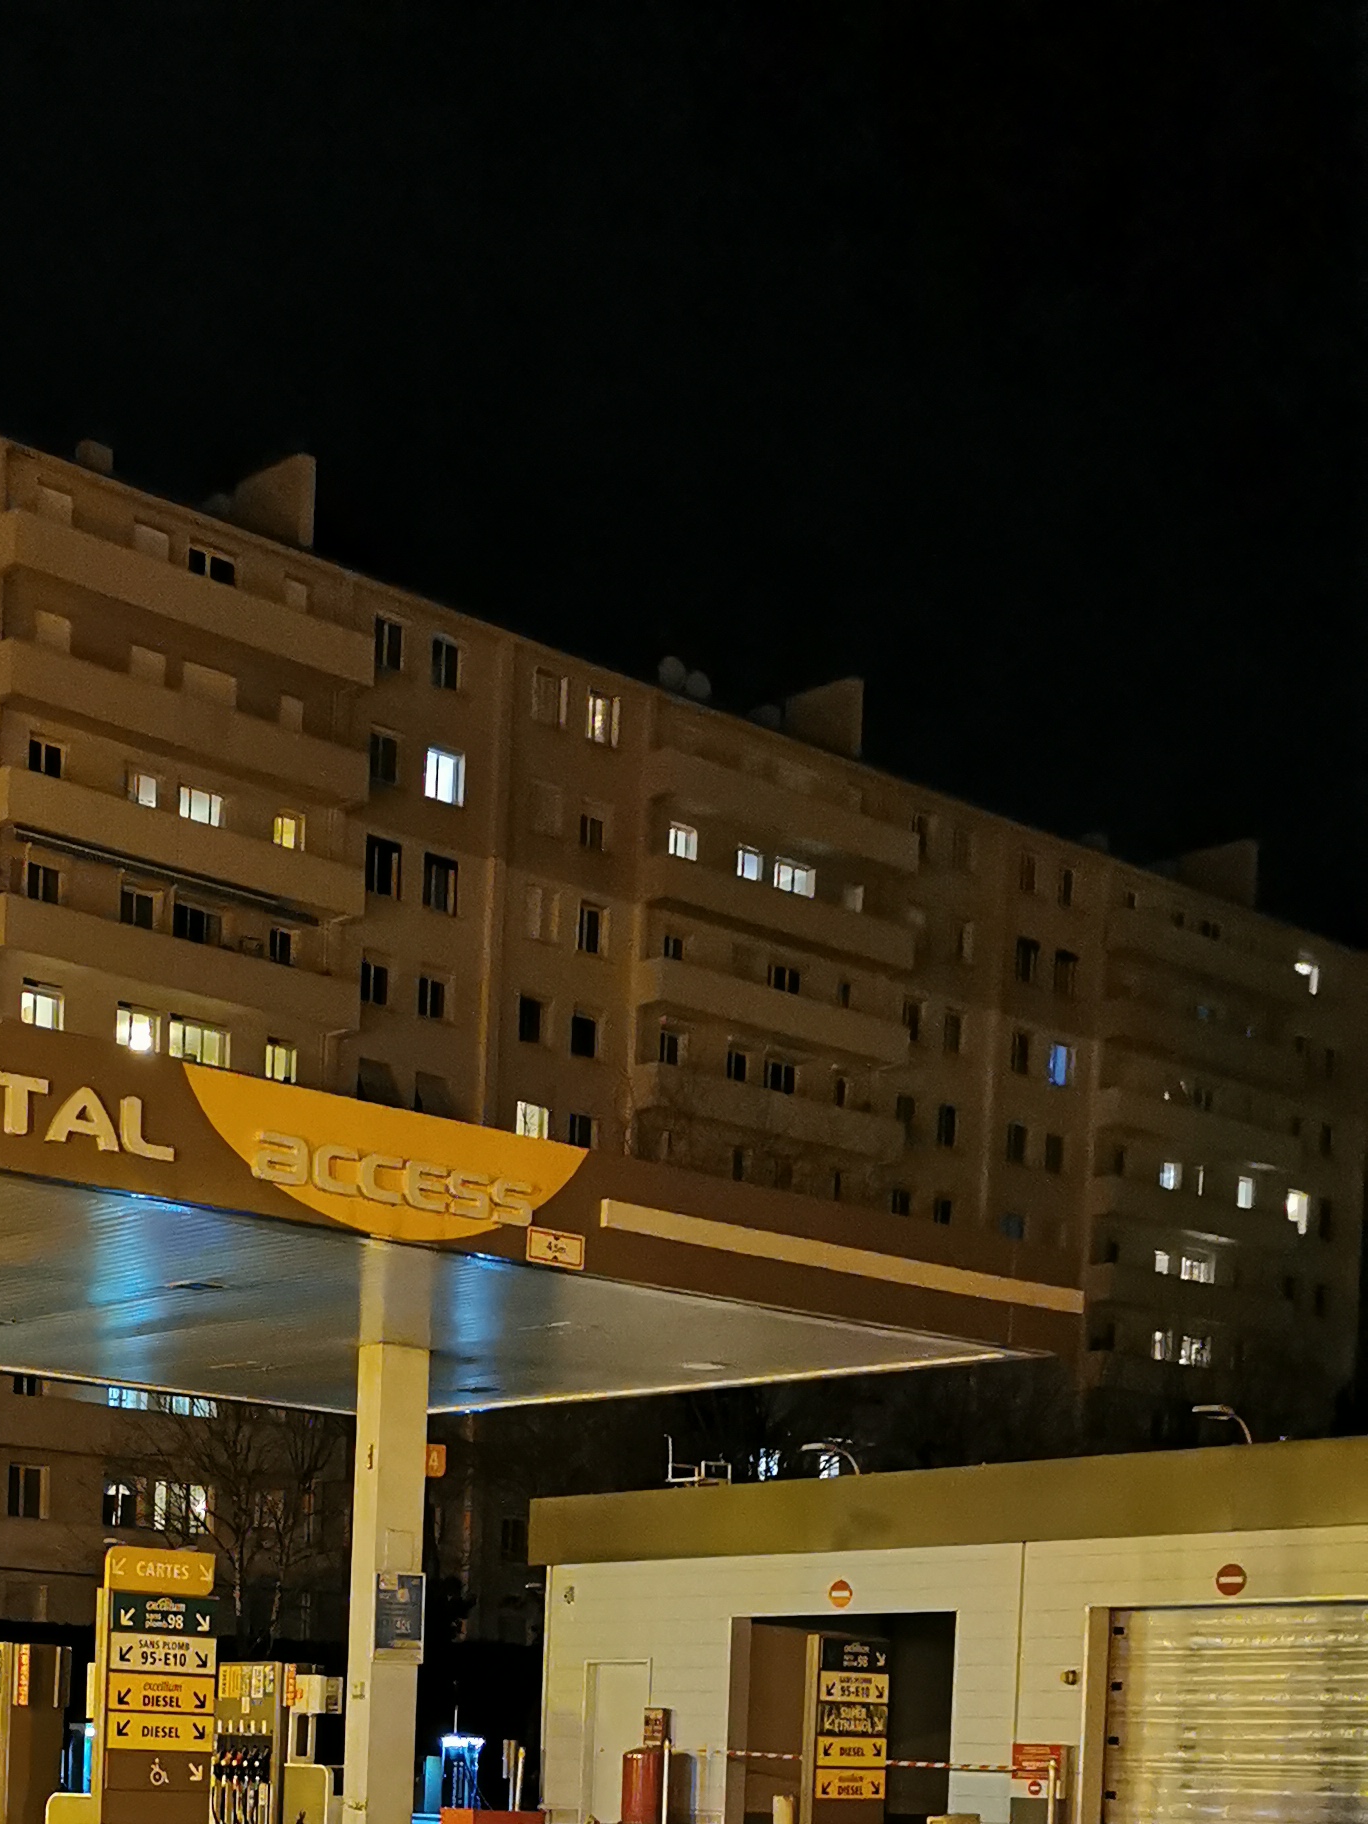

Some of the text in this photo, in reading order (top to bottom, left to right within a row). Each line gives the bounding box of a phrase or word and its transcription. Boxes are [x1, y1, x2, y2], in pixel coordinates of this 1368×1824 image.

[250, 1131, 533, 1227] access
[136, 1560, 189, 1580] CARTES
[167, 1614, 184, 1630] 98
[139, 1639, 190, 1652] SANS PLOMB
[140, 1650, 187, 1668] 95-E10
[142, 1694, 182, 1708] DIESEL
[141, 1725, 181, 1739] DIESEL
[839, 1746, 865, 1757] DIESEL
[837, 1785, 863, 1796] DIESEL
